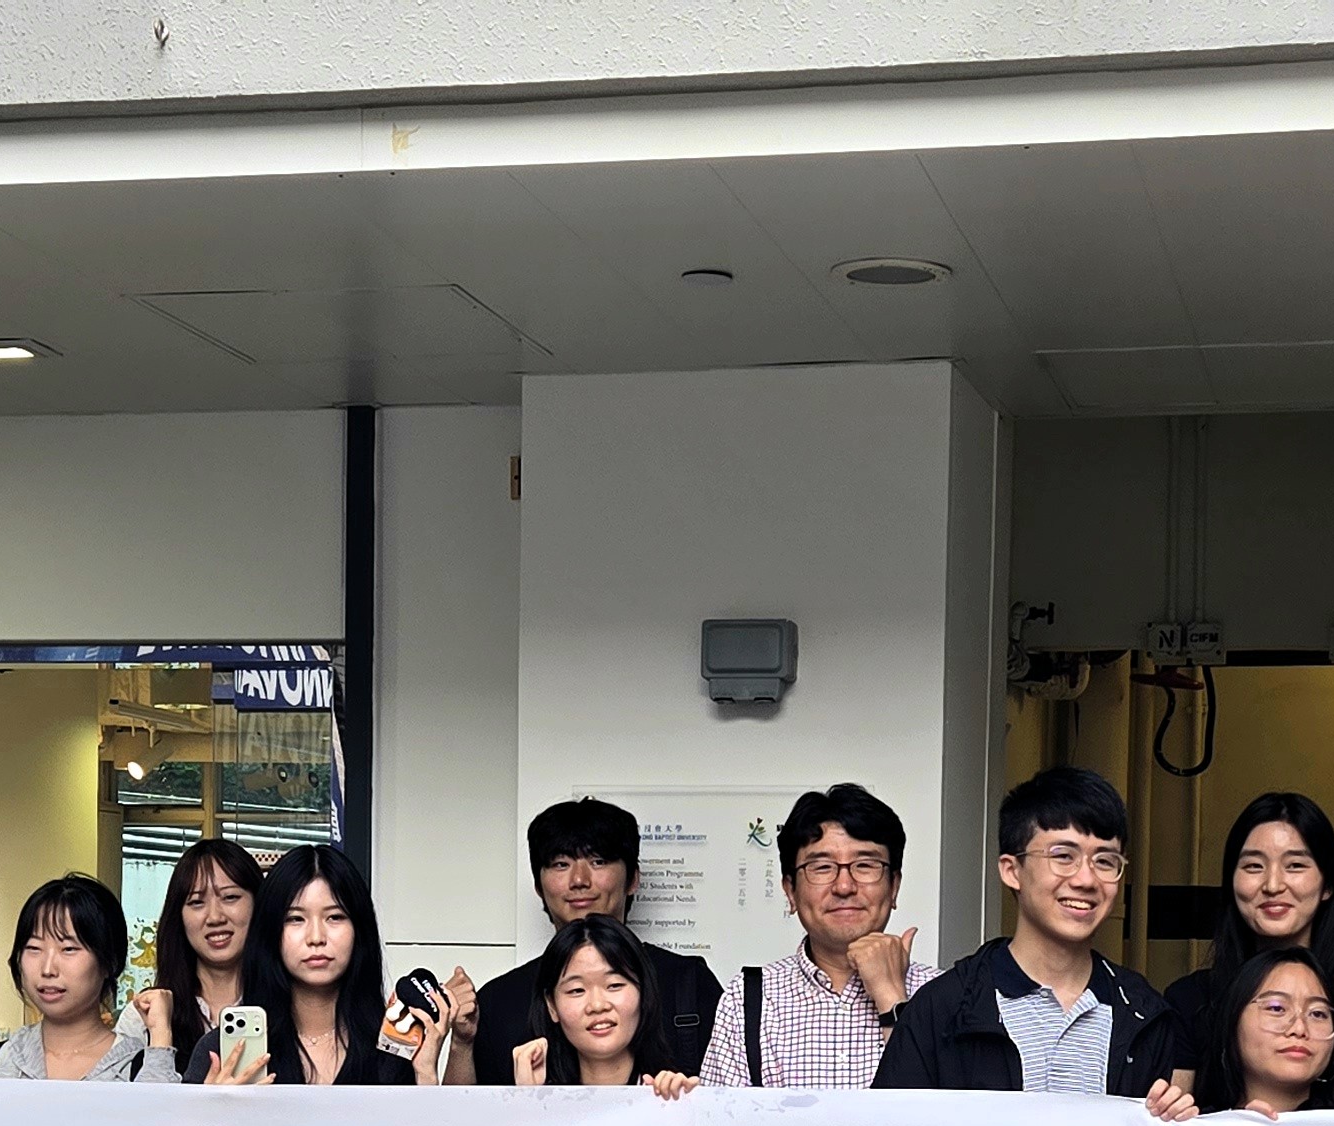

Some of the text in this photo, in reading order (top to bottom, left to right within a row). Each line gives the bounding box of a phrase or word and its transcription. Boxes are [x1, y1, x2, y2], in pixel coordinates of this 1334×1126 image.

[665, 870, 704, 879] Programme
[654, 919, 687, 927] supported
[688, 919, 696, 927] by
